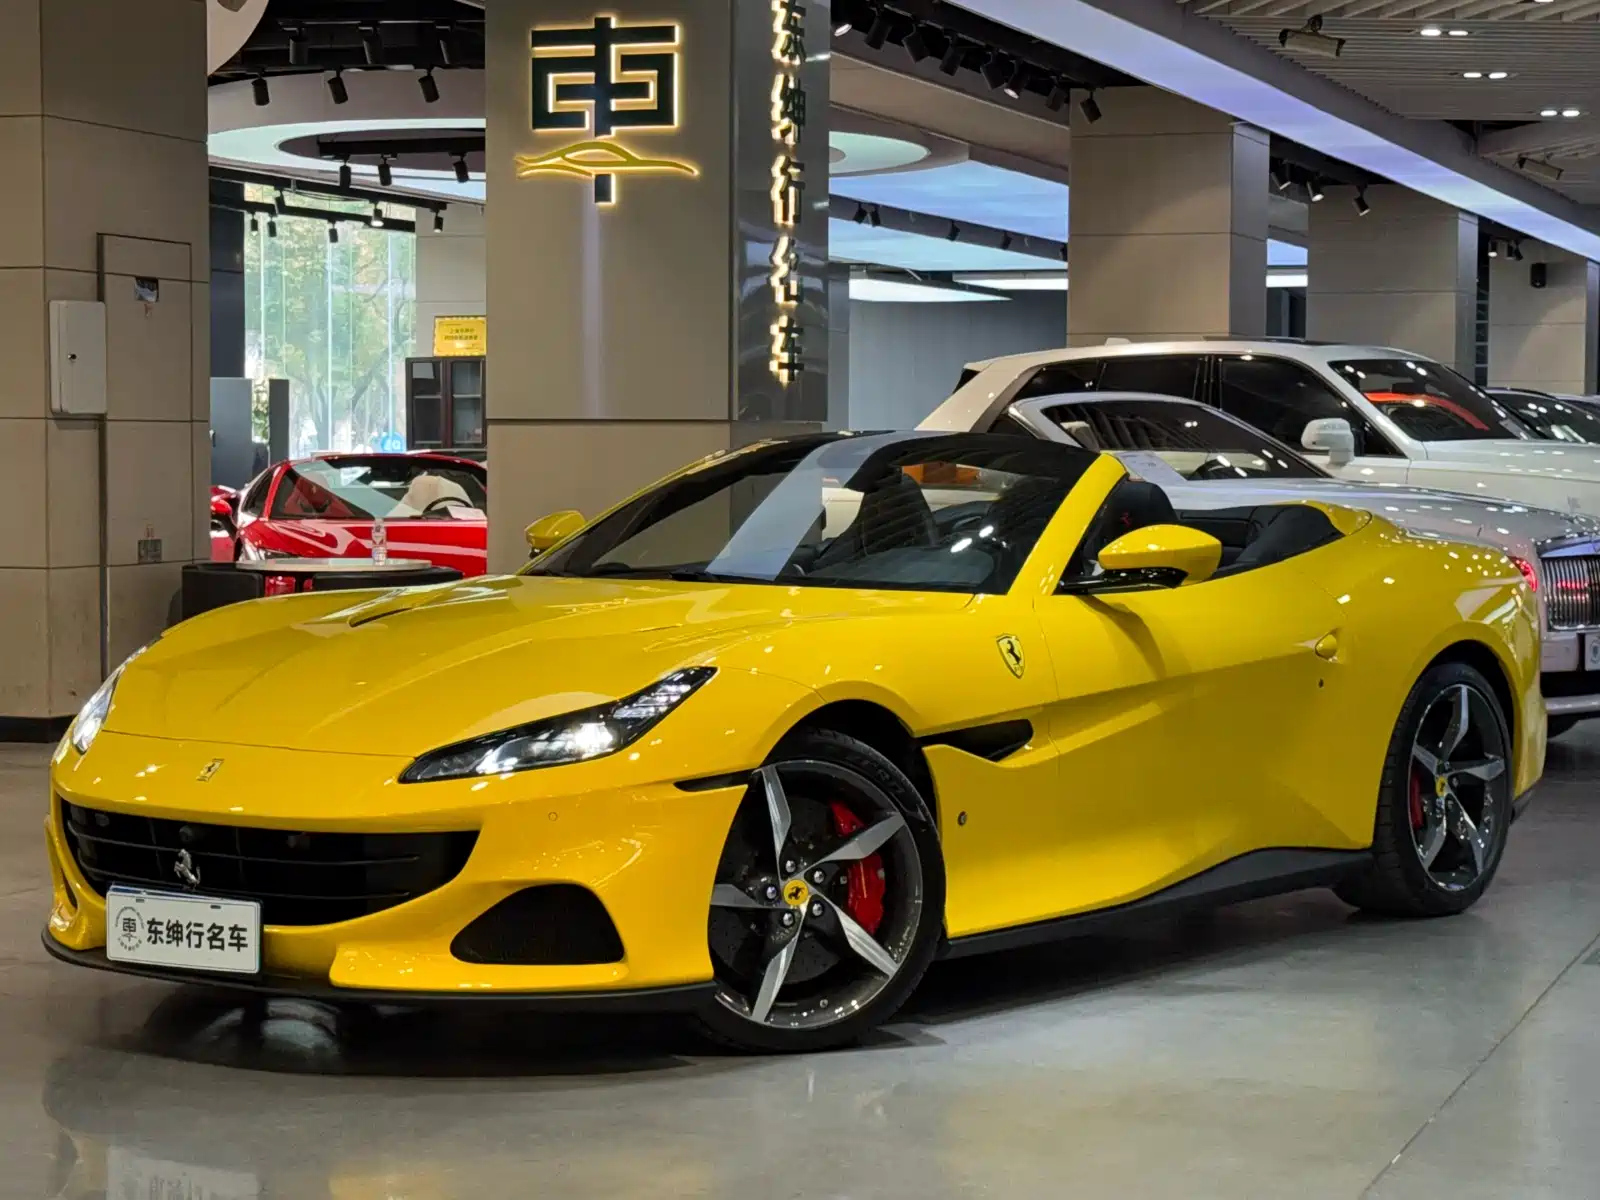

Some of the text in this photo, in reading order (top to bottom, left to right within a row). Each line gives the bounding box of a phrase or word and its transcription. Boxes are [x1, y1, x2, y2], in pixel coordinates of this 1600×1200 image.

[147, 919, 248, 952] 东绅行名车
